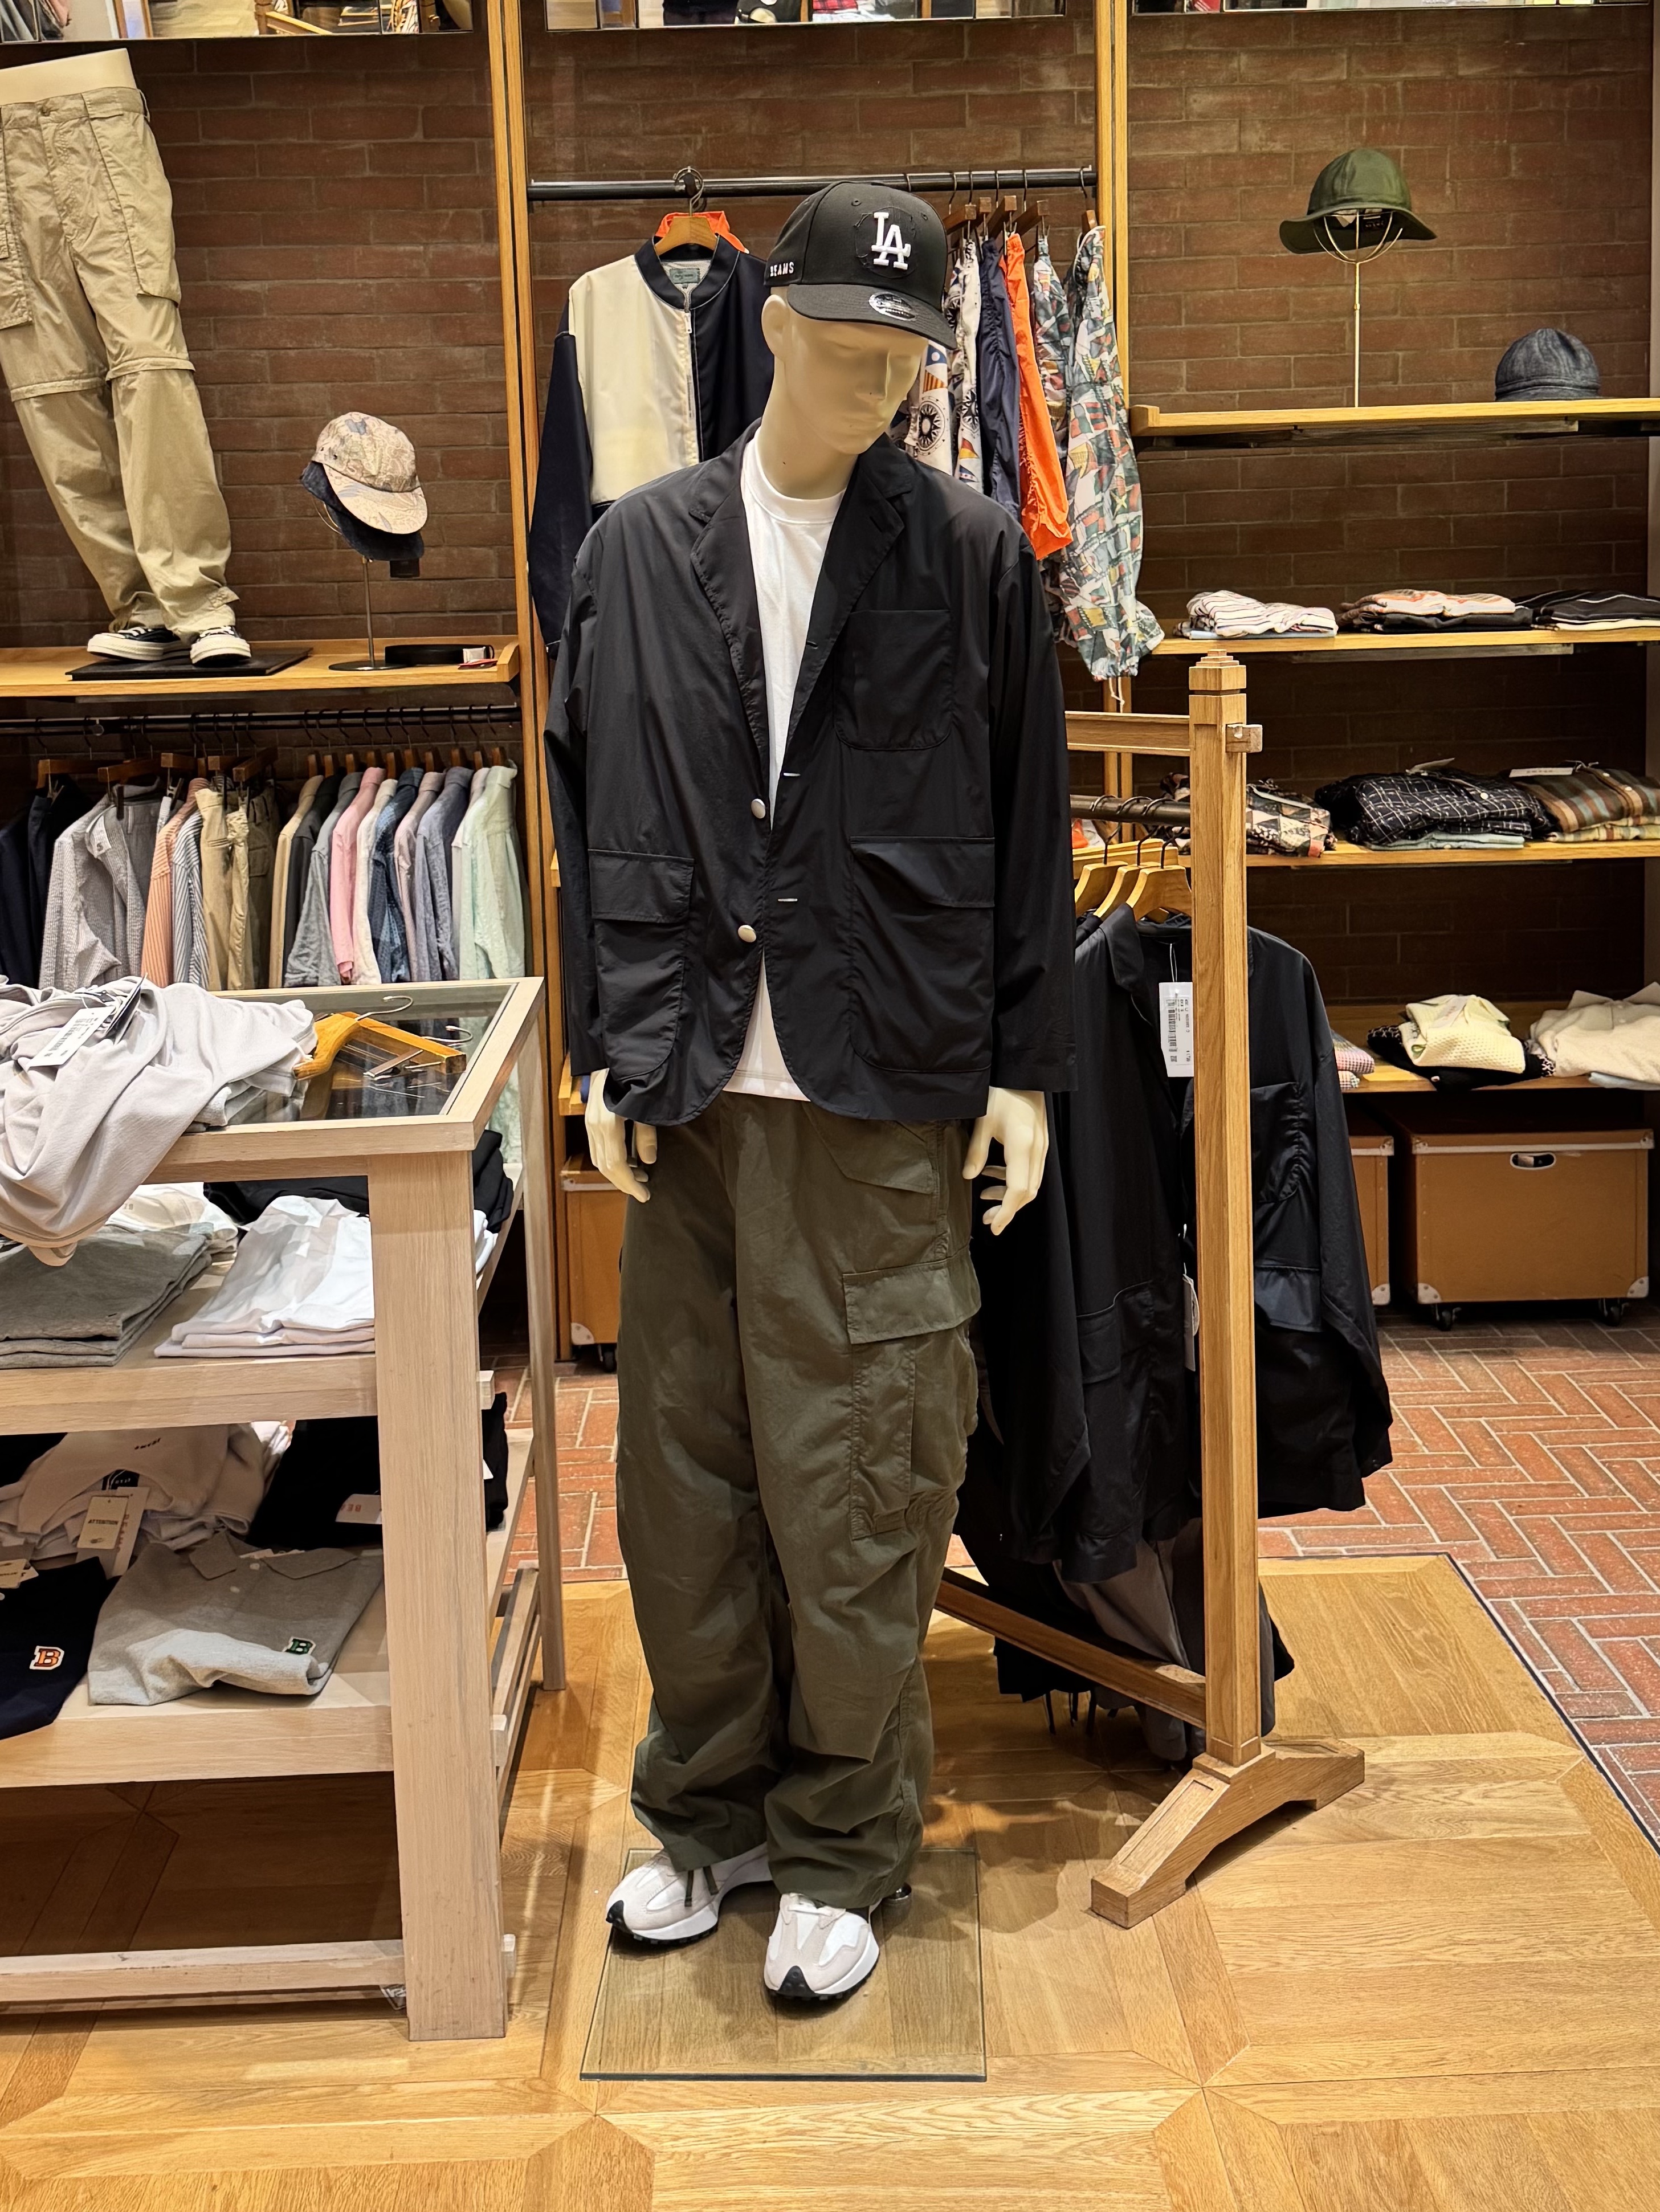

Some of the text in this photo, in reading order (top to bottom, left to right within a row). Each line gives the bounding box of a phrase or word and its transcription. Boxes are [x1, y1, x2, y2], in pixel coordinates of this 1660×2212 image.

[871, 212, 911, 270] LA
[770, 262, 794, 277] BEAMS
[284, 1637, 315, 1655] B
[31, 1646, 63, 1669] B
